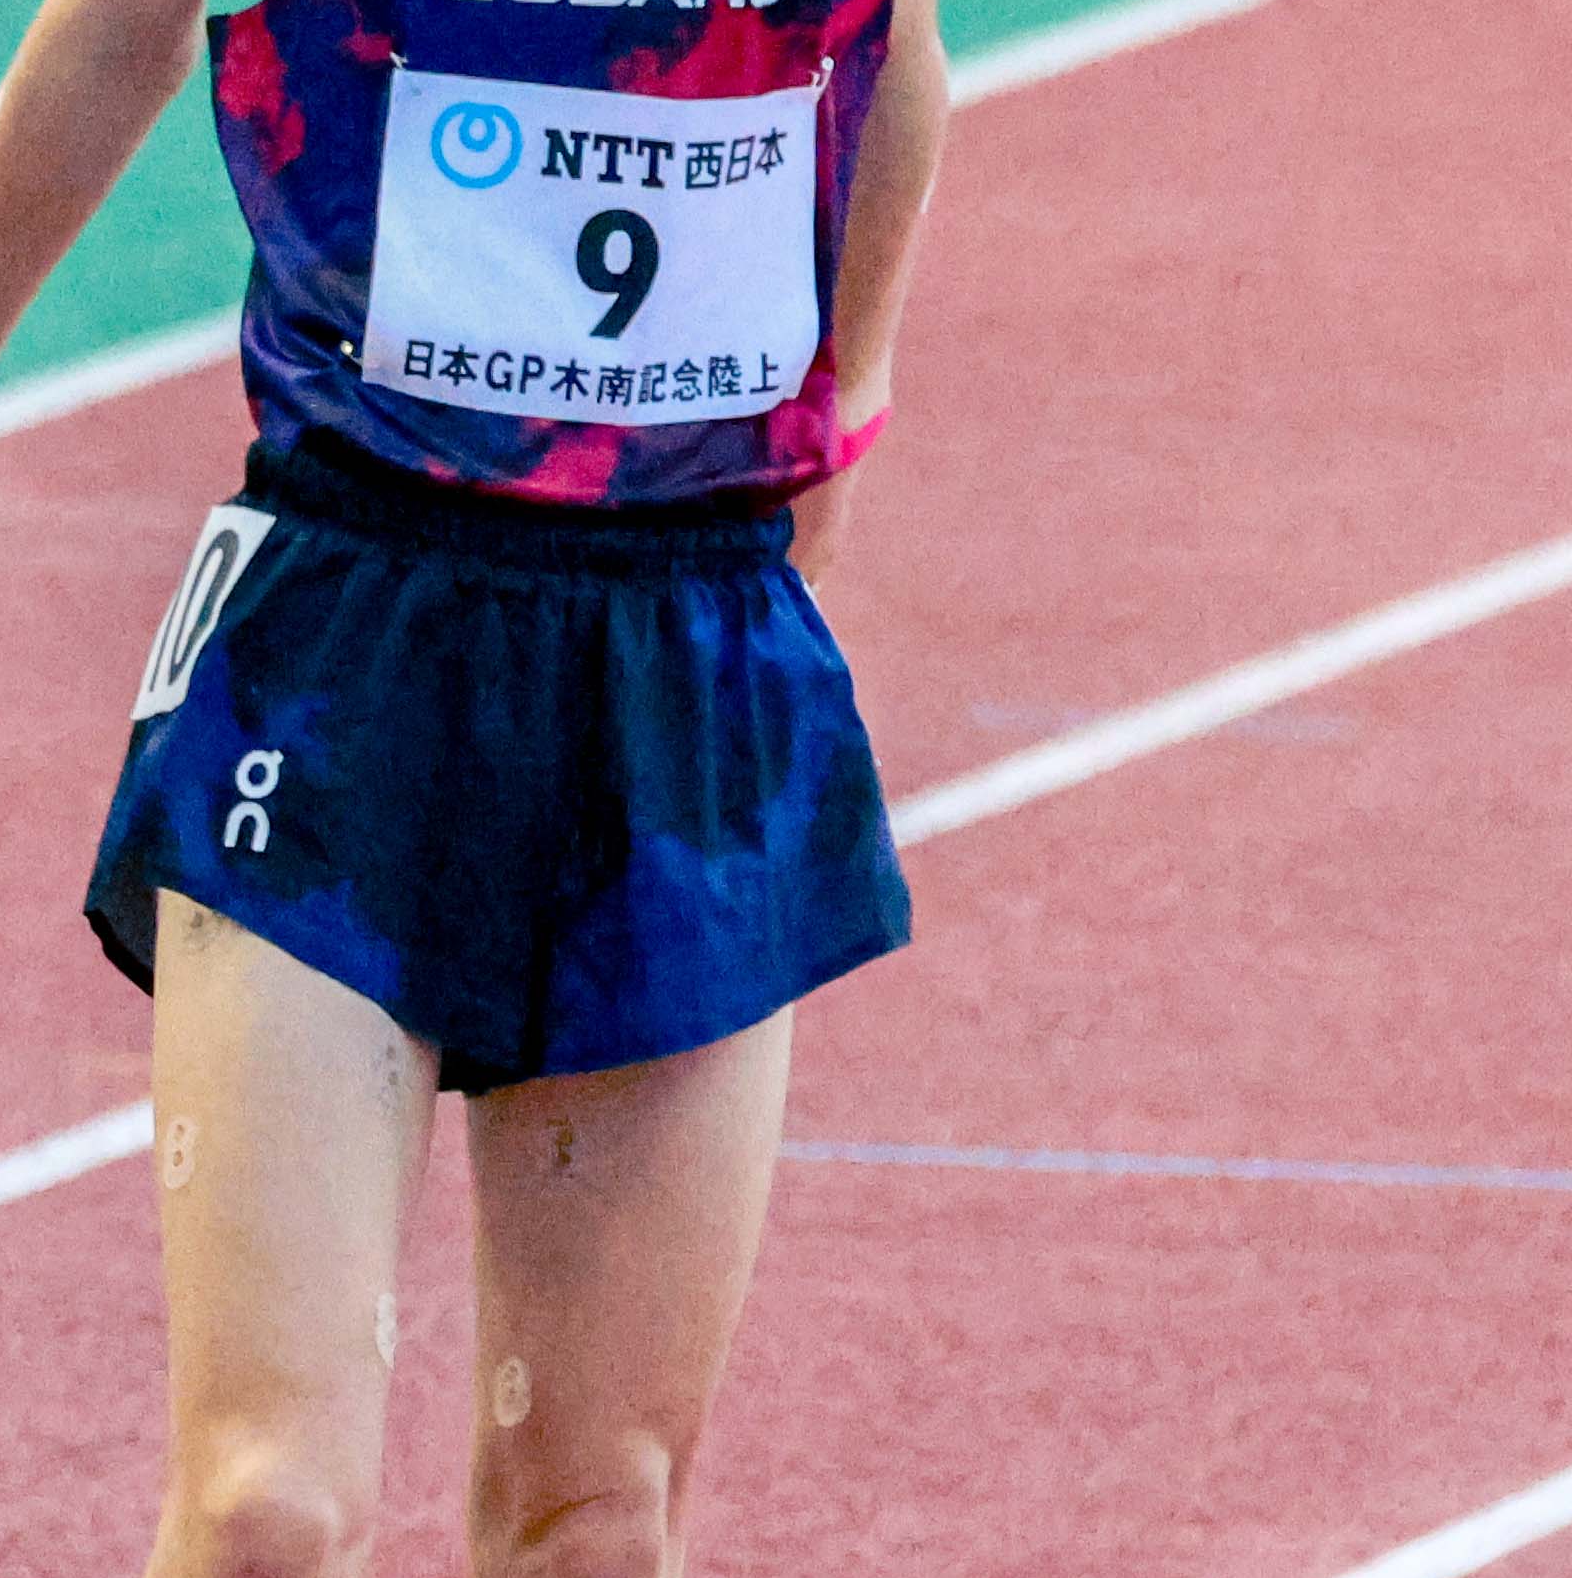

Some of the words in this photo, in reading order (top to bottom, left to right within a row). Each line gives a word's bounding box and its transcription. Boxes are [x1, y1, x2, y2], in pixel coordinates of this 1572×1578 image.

[575, 209, 660, 341] 9
[403, 340, 780, 408] 日本GP木南記念陸上
